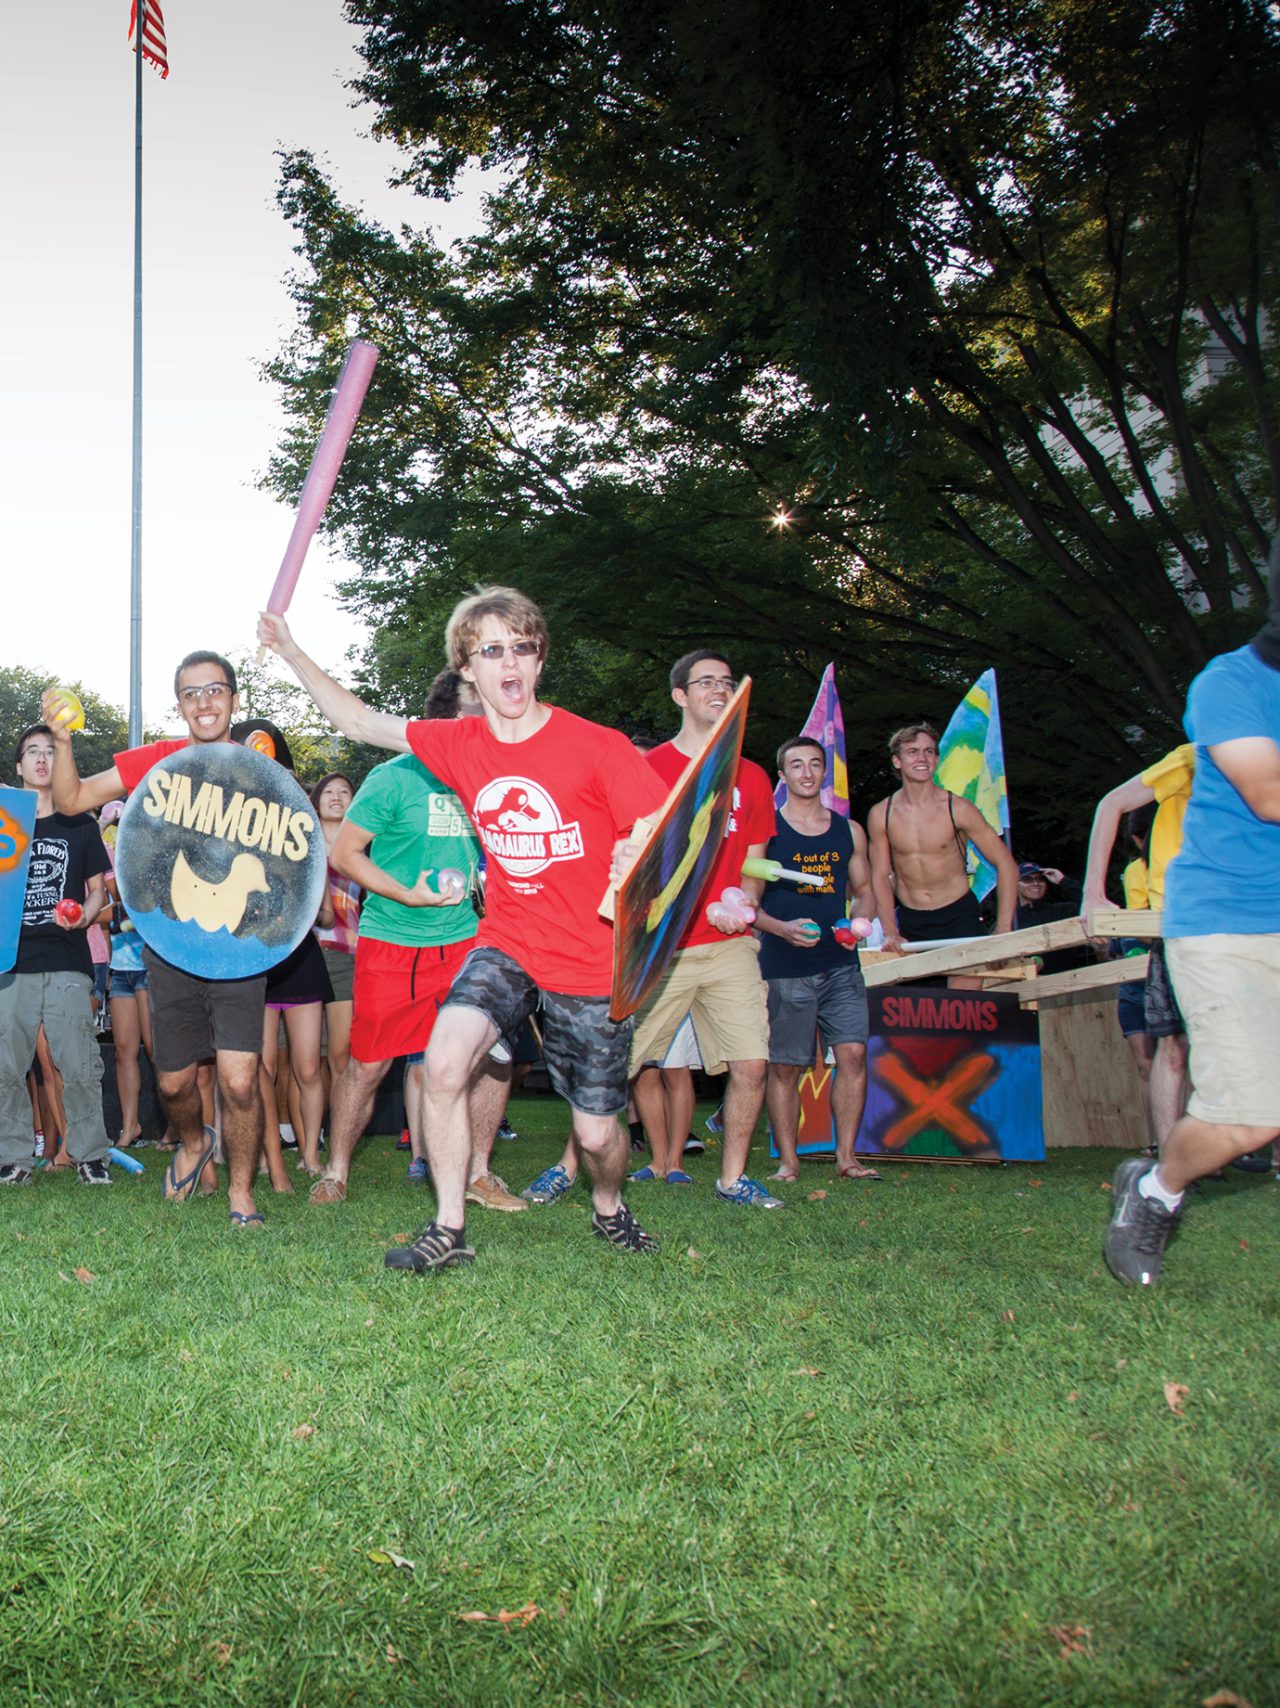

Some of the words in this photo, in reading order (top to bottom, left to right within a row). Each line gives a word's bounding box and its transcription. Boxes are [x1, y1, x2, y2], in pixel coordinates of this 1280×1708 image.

[434, 797, 446, 812] Q
[142, 768, 315, 862] SIMMONS
[484, 828, 546, 858] NOSAURUS
[549, 830, 580, 856] REX
[792, 852, 802, 862] 4
[803, 853, 818, 862] out
[819, 852, 829, 861] of
[831, 852, 840, 861] 3
[801, 863, 831, 875] people
[797, 885, 814, 894] with
[24, 897, 60, 908] ACKERS
[882, 996, 998, 1032] SIMMONS
